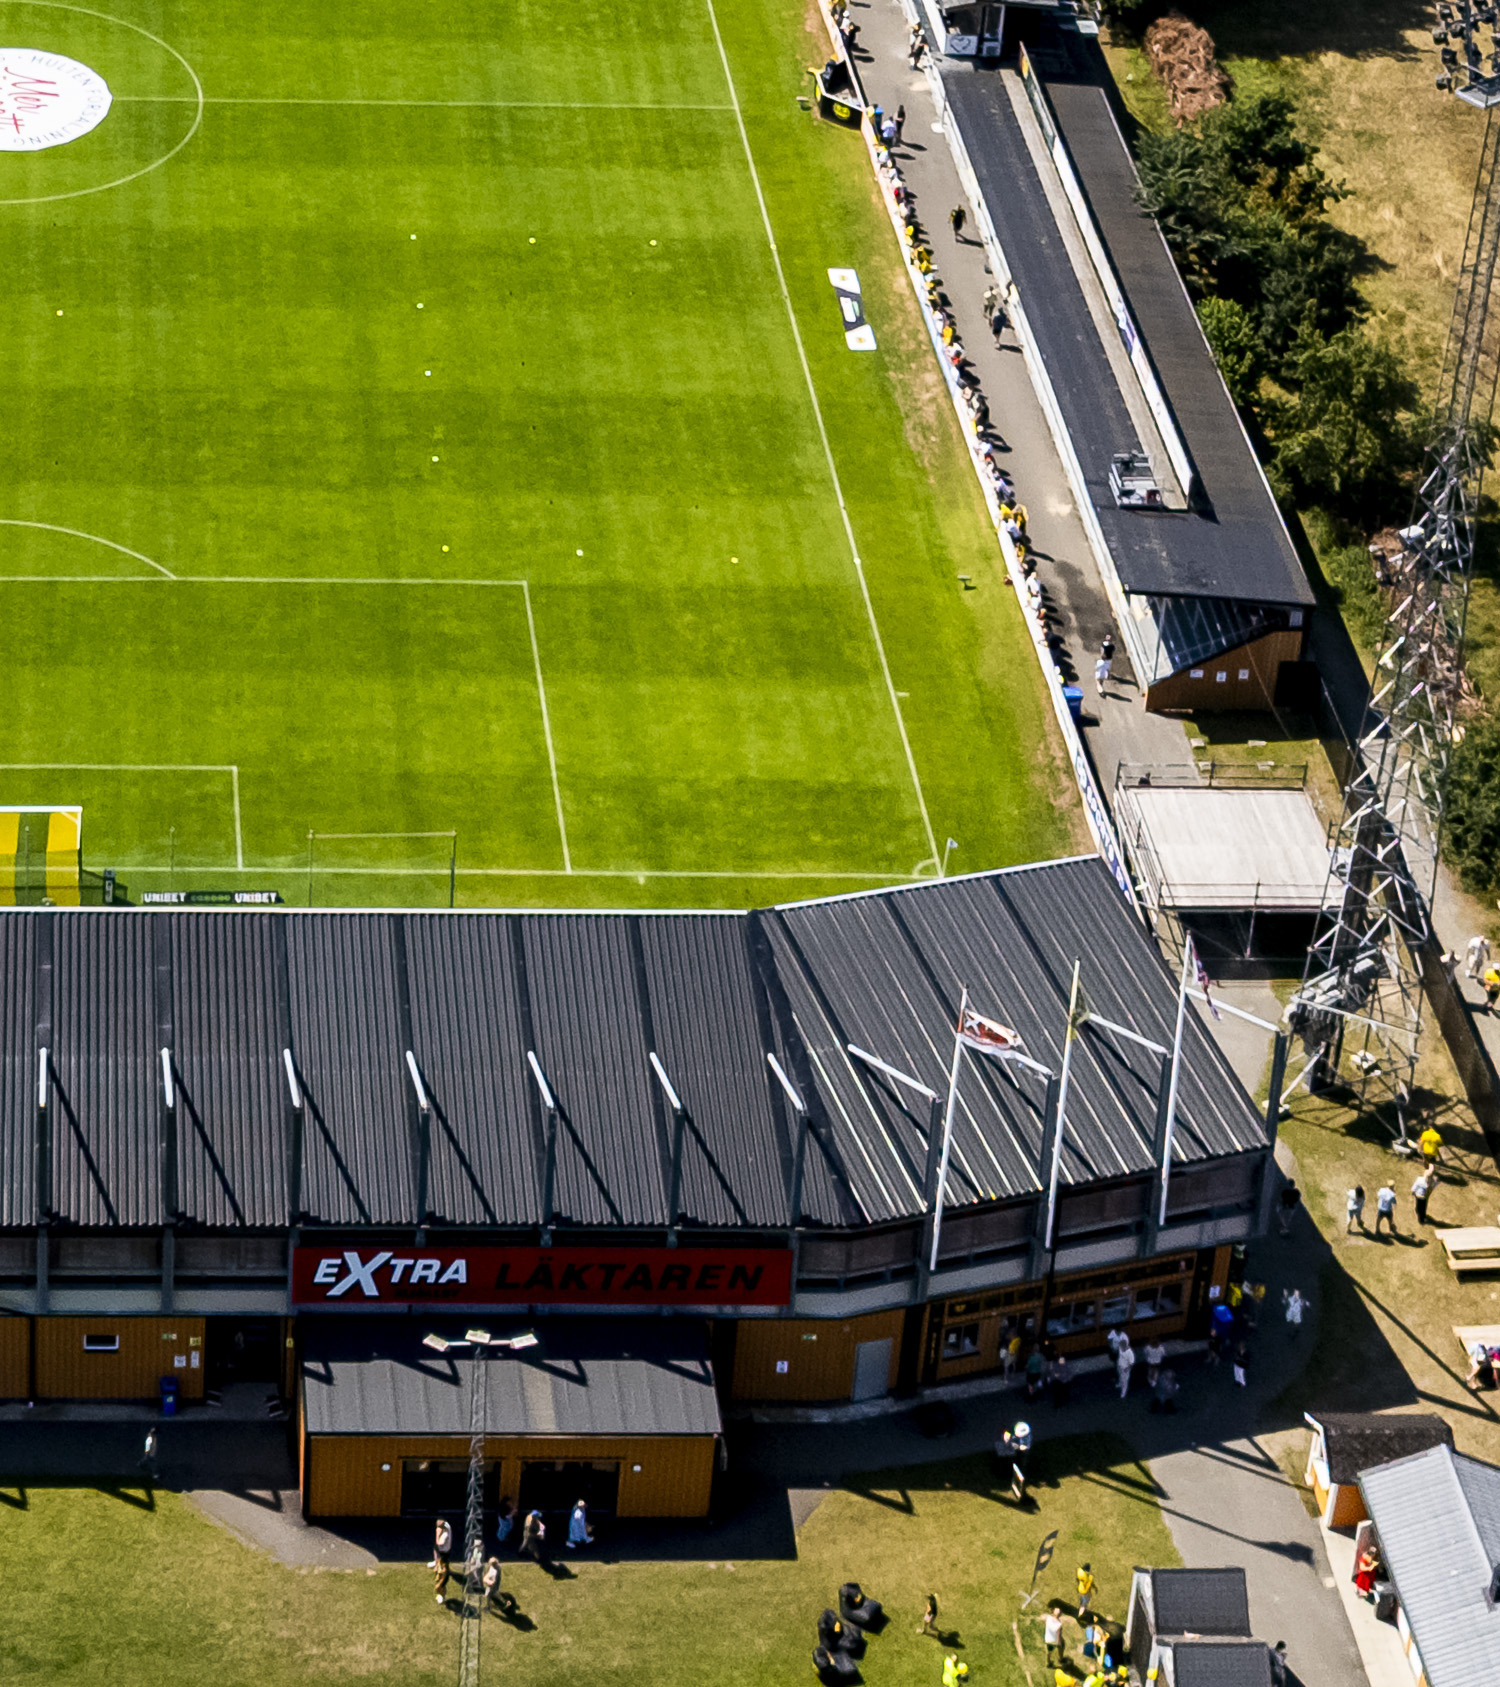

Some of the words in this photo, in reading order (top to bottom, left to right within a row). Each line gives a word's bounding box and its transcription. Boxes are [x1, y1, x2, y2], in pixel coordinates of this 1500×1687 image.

[144, 892, 186, 903] UNIBET
[235, 892, 277, 903] UNIBET
[313, 1251, 468, 1298] EXTRA
[493, 1256, 764, 1292] LÄKTAREN
